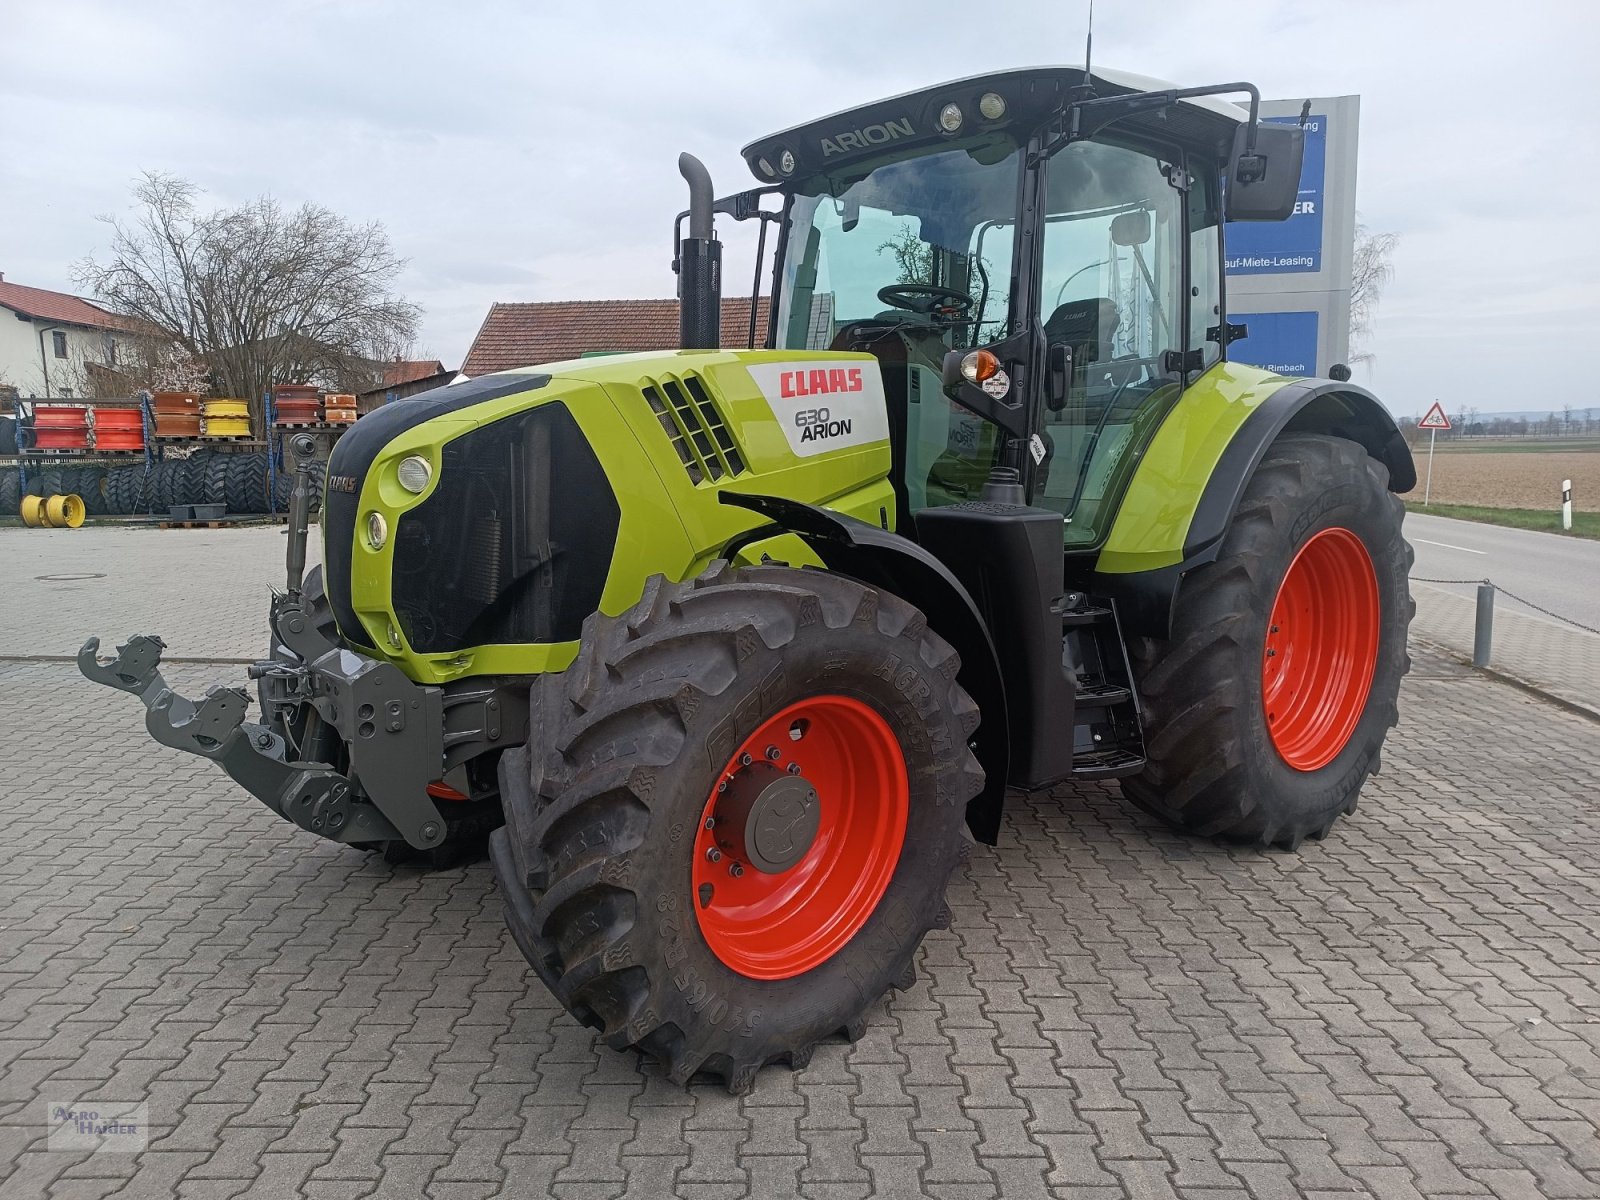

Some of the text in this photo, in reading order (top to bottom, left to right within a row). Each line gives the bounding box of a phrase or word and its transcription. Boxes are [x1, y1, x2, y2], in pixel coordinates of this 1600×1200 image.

[820, 117, 916, 157] ARION
[1225, 256, 1313, 269] auf-Miete-Leasing
[1267, 363, 1305, 373] Rimbach
[780, 368, 863, 399] CLAAS
[795, 407, 830, 428] 630
[800, 419, 852, 443] ARION
